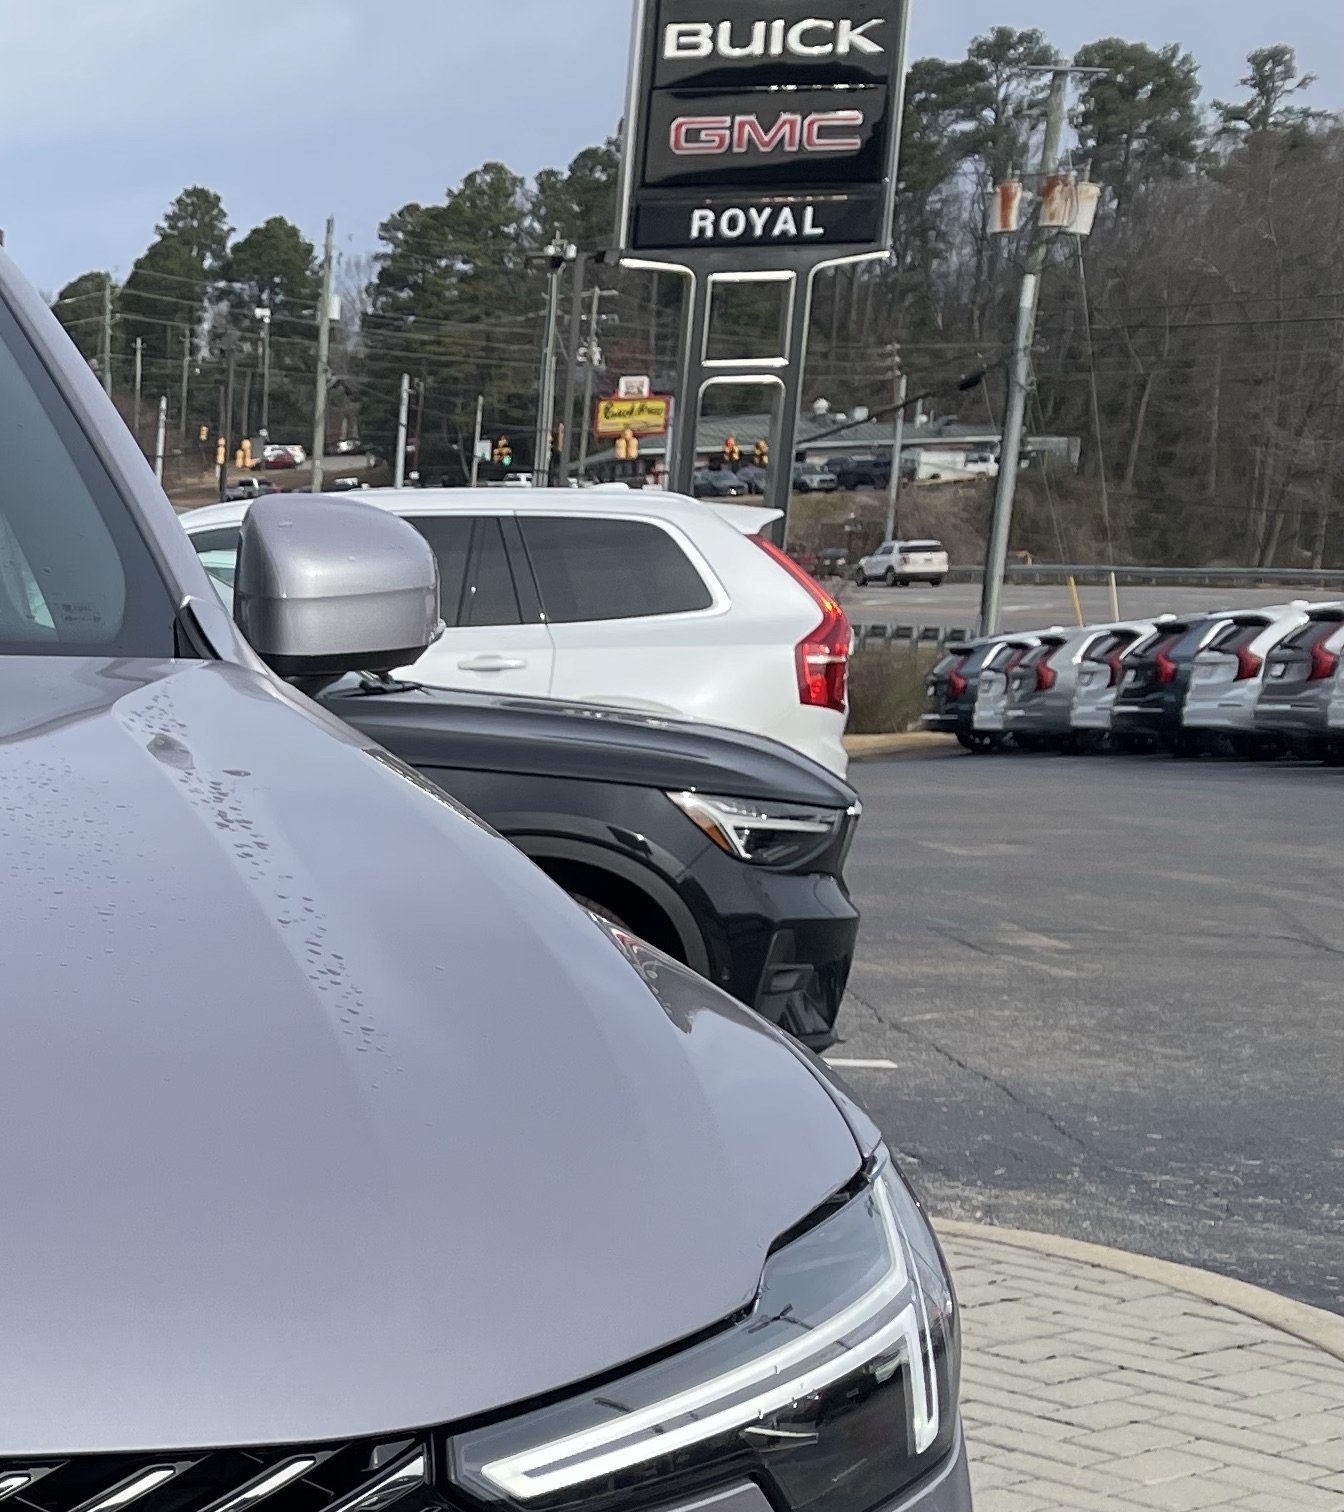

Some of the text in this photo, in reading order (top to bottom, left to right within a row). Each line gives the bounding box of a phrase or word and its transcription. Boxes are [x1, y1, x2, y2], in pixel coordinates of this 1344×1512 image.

[664, 18, 885, 59] BUICK
[670, 110, 864, 155] GMC
[690, 205, 825, 240] ROYAL
